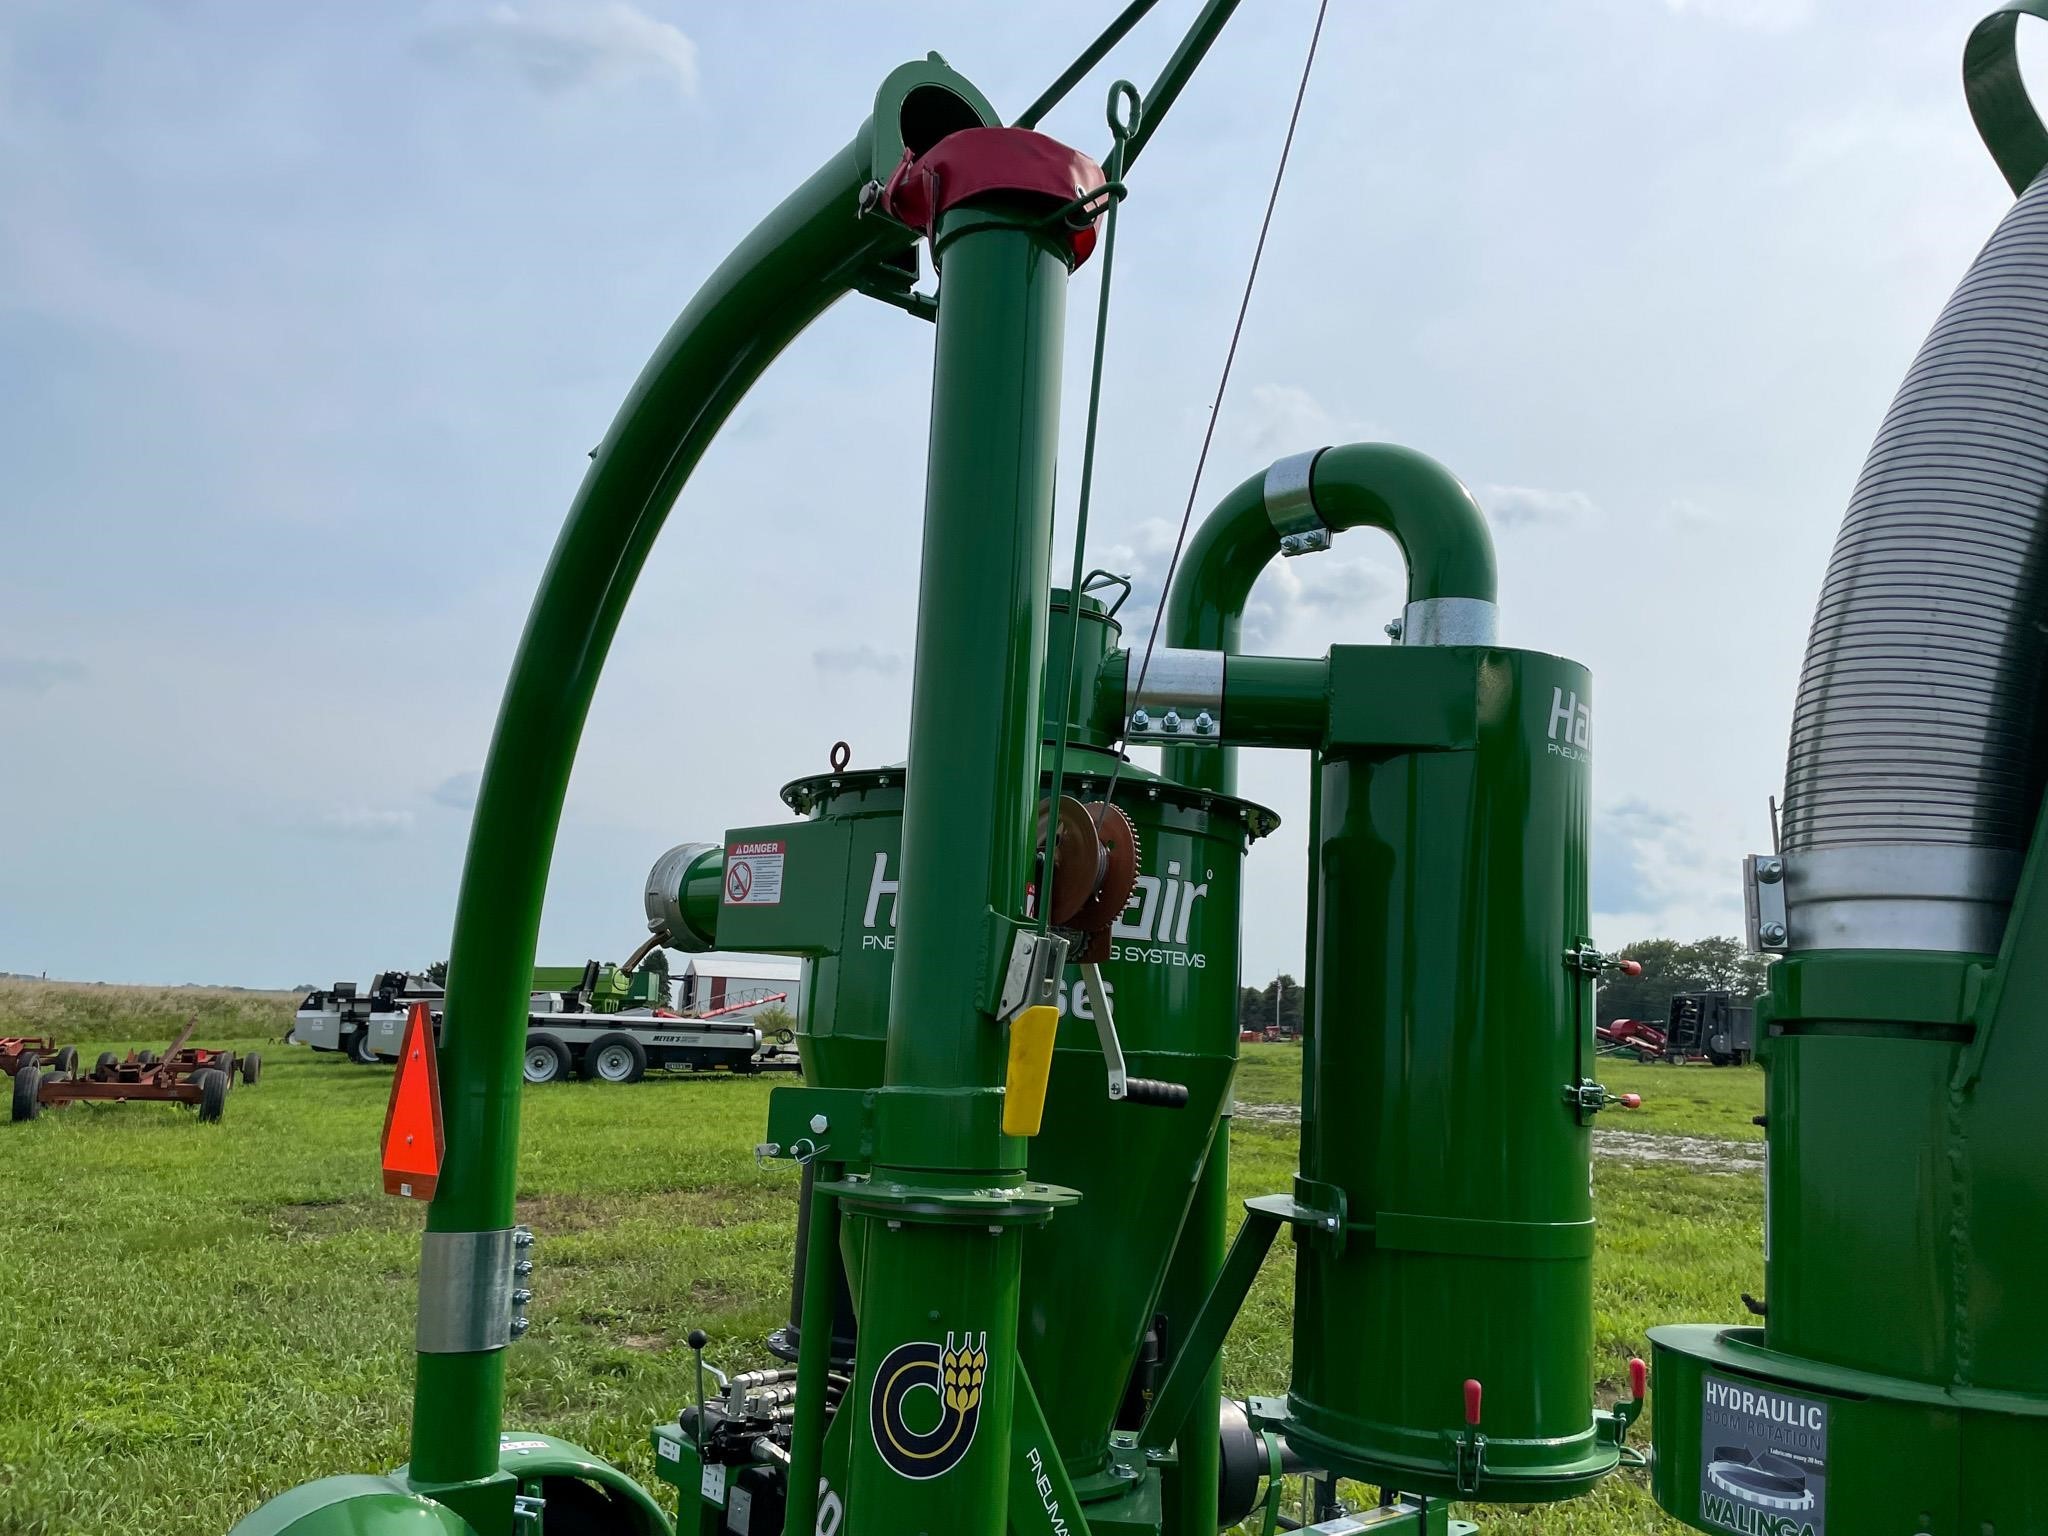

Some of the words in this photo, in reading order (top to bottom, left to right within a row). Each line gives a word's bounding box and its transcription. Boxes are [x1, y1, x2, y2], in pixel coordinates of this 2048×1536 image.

[743, 843, 778, 854] DANGER
[1124, 946, 1206, 969] SYSTEMS
[1706, 1381, 1822, 1431] HYDRAULIC
[1746, 1418, 1822, 1452] ROTATION
